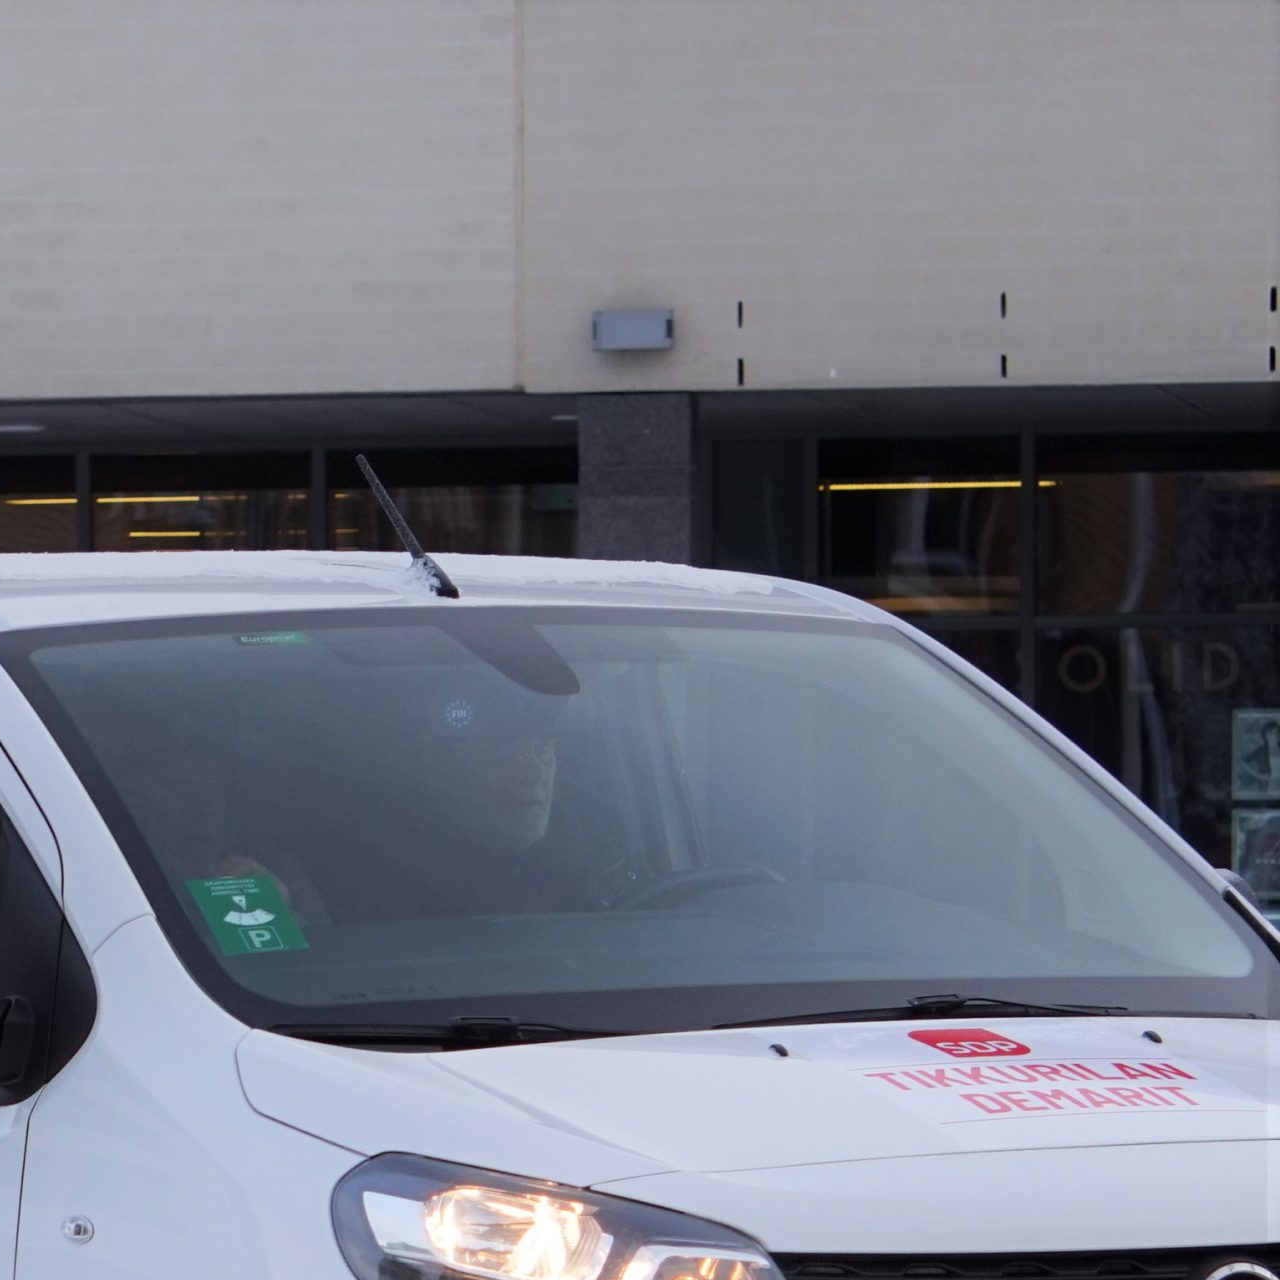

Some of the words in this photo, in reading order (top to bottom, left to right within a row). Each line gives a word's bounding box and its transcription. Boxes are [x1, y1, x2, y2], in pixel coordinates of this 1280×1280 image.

[1016, 641, 1240, 692] OLID
[248, 929, 271, 948] P
[935, 1040, 1019, 1055] SDP
[864, 1062, 1199, 1091] TIKKURILAN
[959, 1085, 1201, 1114] DEMARIT
